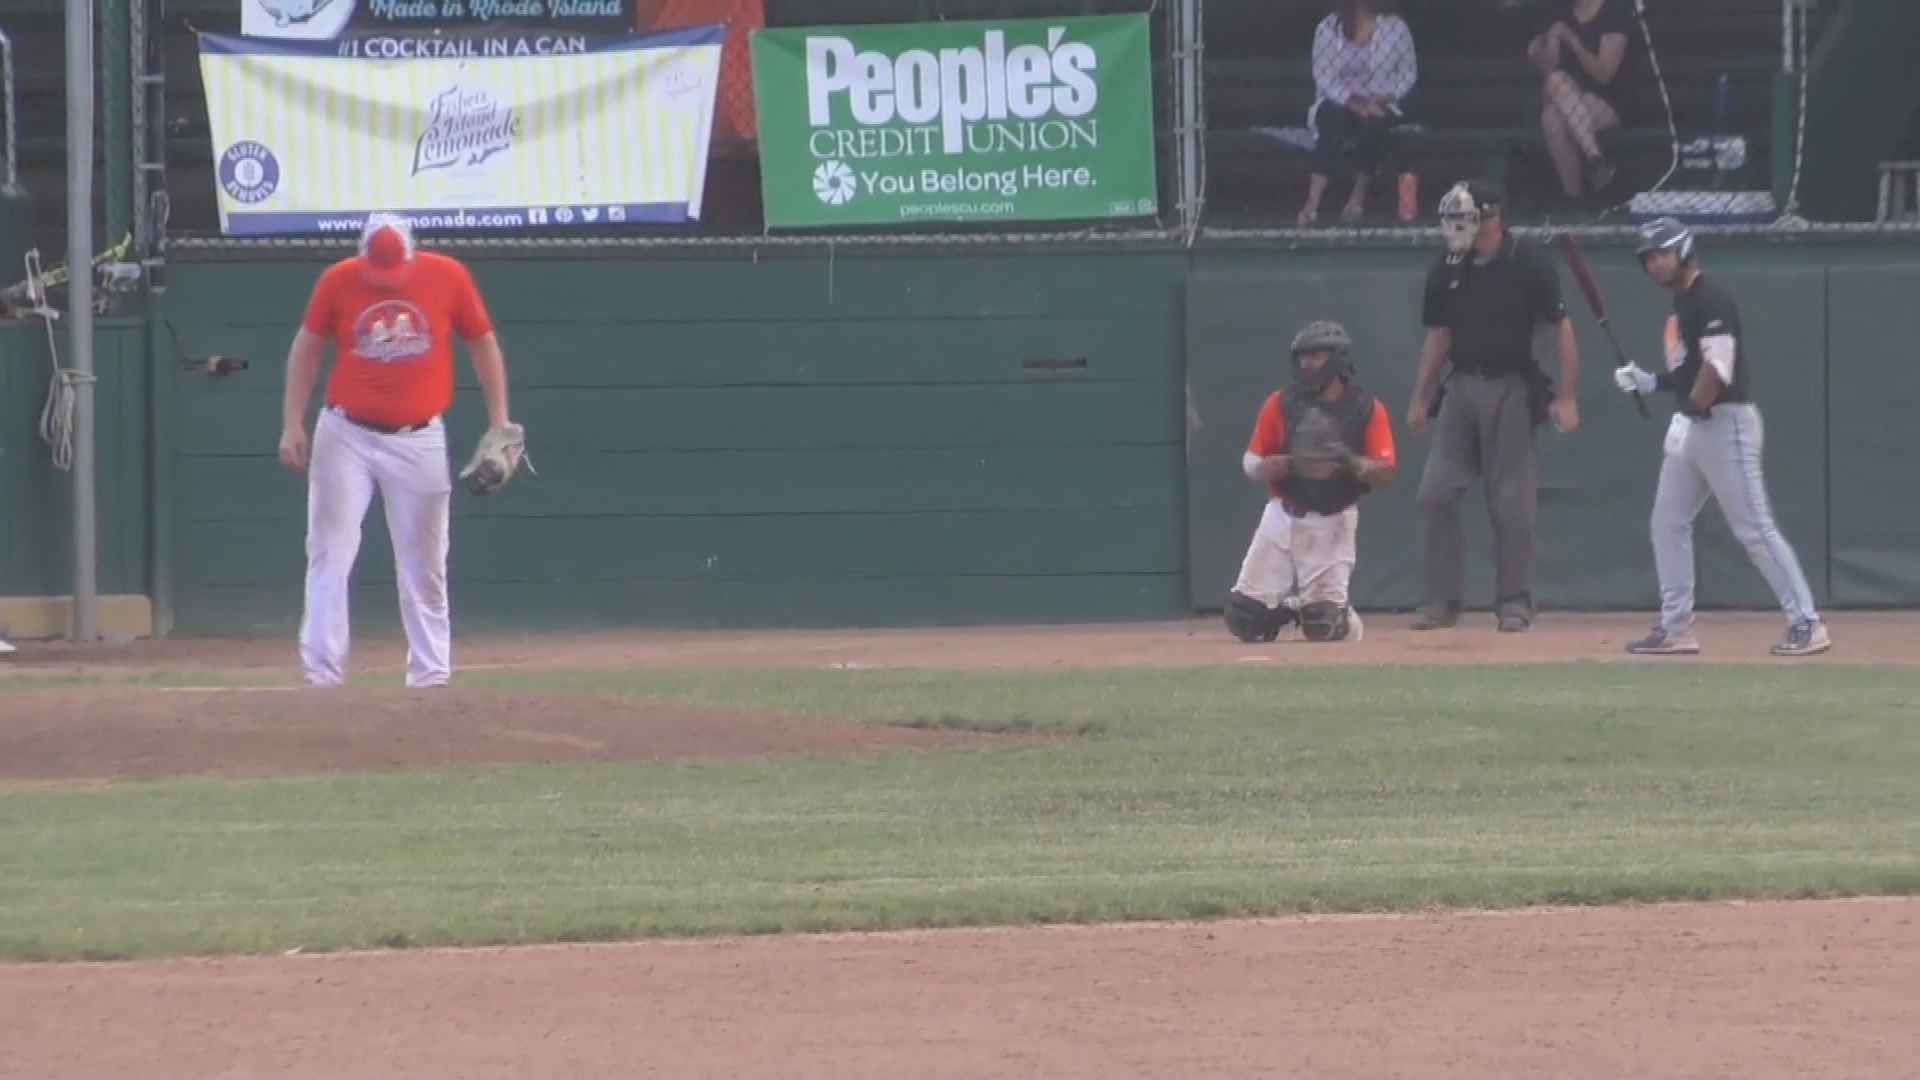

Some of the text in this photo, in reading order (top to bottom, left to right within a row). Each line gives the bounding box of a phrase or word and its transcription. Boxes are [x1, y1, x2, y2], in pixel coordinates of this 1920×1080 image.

[369, 0, 622, 21] Made in Rhode Island
[364, 37, 477, 58] COCKTAIL
[484, 37, 507, 56] IN
[514, 37, 530, 55] A
[535, 36, 586, 55] CAN
[806, 26, 1097, 154] People's
[411, 106, 521, 177] Lemonade
[810, 119, 1098, 159] CREDIT UNION
[861, 165, 1097, 194] You Belong Here.
[900, 201, 1015, 217] peoplescu.com
